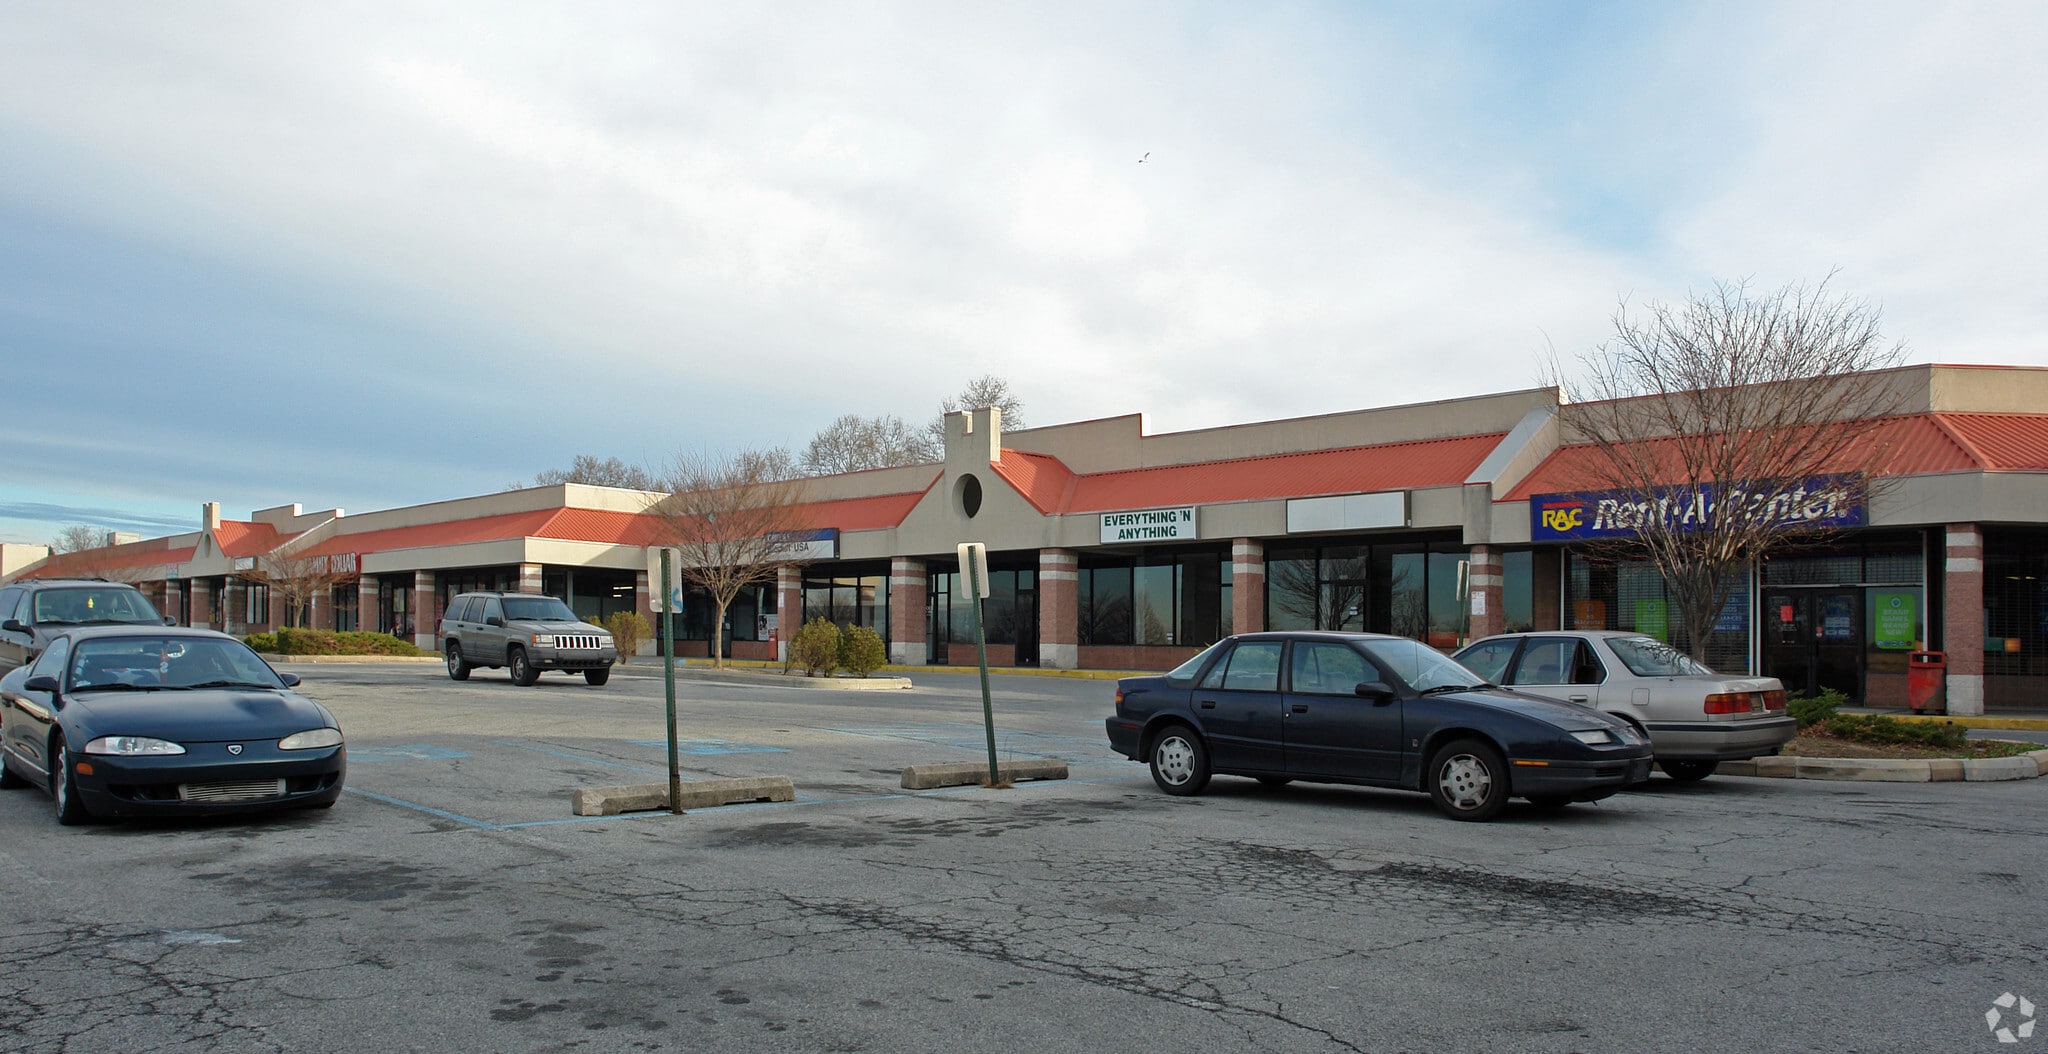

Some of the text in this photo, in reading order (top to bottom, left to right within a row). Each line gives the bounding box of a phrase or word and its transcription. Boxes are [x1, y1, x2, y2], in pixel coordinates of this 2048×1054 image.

[1104, 511, 1177, 527] EVERYTHING
[1542, 508, 1582, 532] RAC
[1118, 525, 1177, 540] ANYTHING
[794, 542, 809, 552] USA
